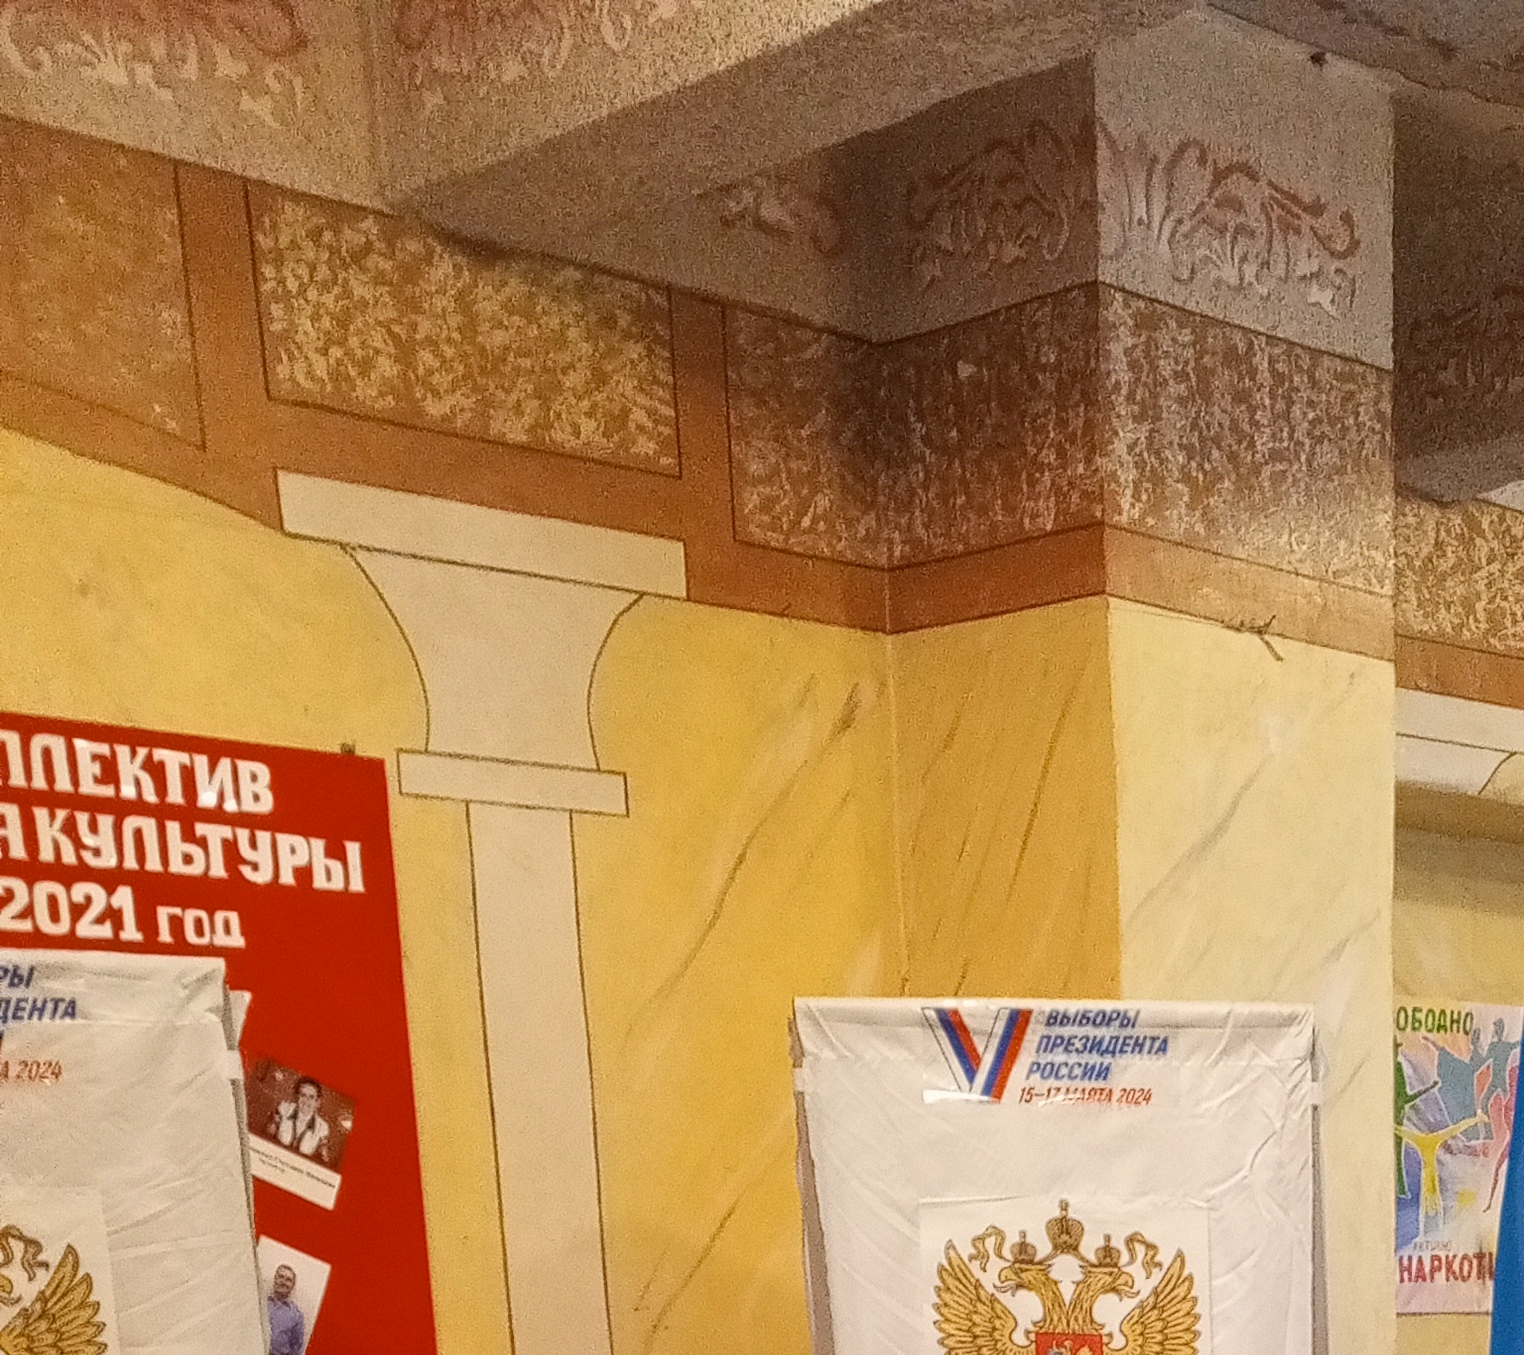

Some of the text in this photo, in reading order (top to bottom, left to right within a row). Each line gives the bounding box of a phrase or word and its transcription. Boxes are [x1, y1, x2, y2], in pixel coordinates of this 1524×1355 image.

[32, 806, 366, 894] КУЛЬТУРЫ
[0, 877, 246, 948] 2021 год
[1044, 1008, 1140, 1029] ВЫБОРЫ
[1035, 1034, 1169, 1057] ПРЕЗИДЕНТА
[15, 1060, 62, 1081] 2024
[1025, 1061, 1113, 1082] РОССИИ
[1116, 1088, 1153, 1105] 2024
